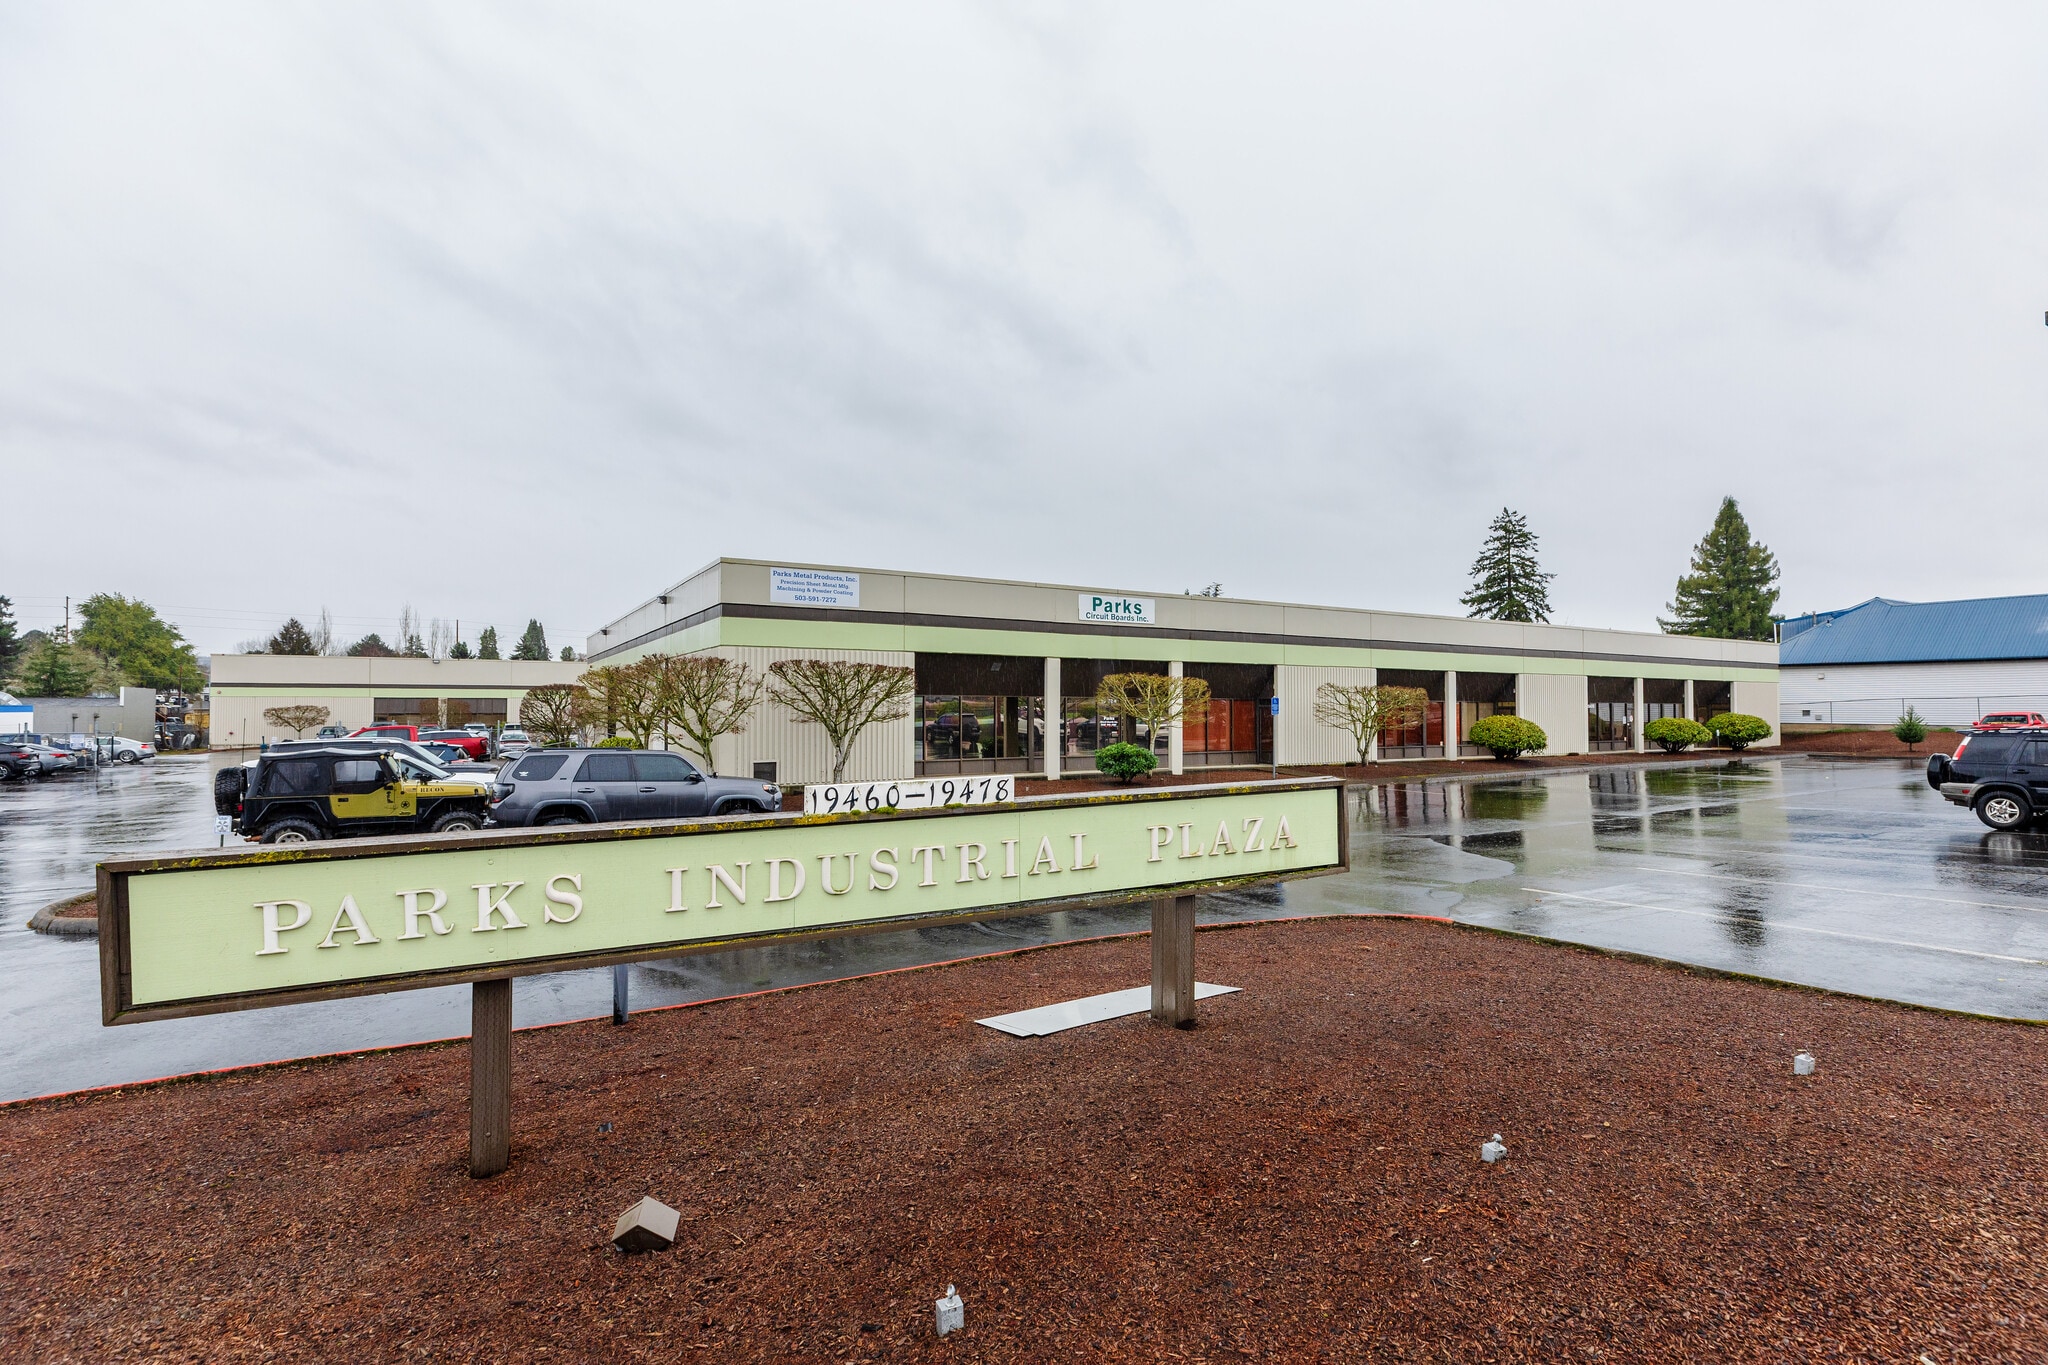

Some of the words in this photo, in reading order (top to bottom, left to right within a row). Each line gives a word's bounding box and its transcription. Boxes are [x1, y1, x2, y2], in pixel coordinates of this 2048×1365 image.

[794, 595, 837, 603] 503-591-7272
[1092, 597, 1142, 614] Parks
[1085, 612, 1109, 620] Circuit
[253, 873, 584, 956] PARKS
[664, 832, 1099, 913] INDUSTRIAL
[1146, 814, 1299, 863] PLAZA
